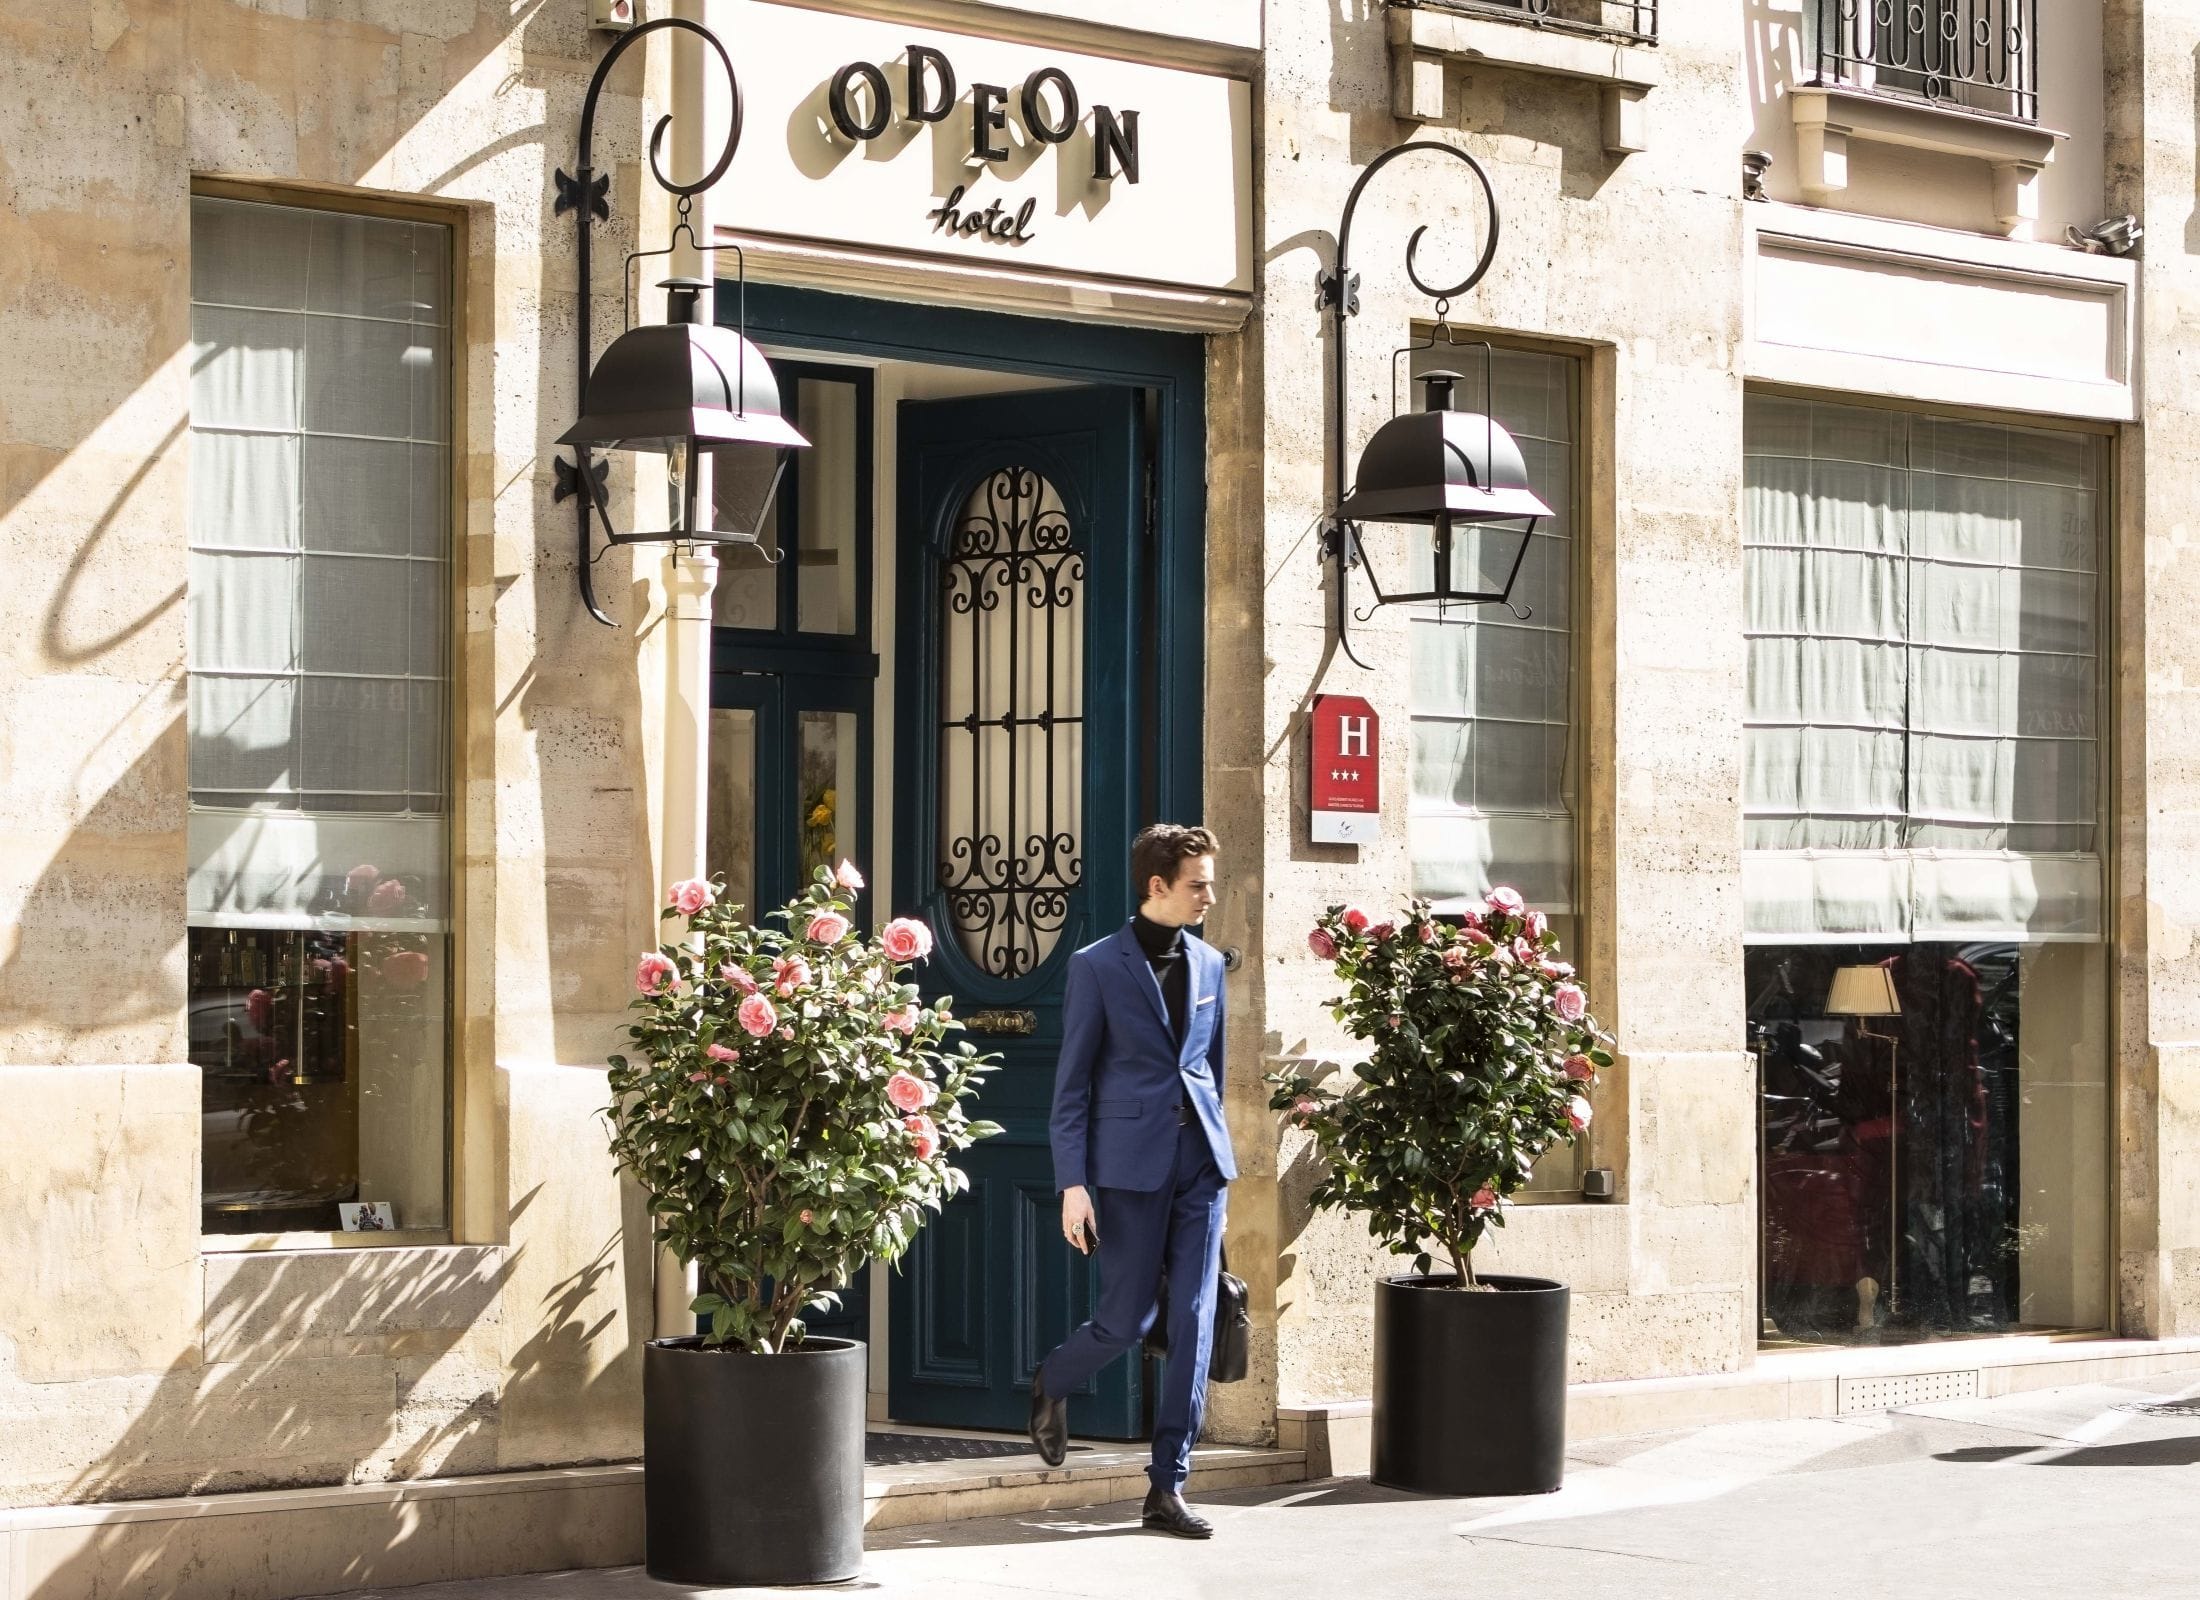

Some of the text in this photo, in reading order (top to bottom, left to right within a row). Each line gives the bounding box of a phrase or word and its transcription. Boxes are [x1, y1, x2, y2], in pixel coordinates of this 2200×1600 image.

[829, 45, 1140, 184] ODEON
[934, 186, 1036, 241] hotel
[1338, 715, 1371, 757] H
